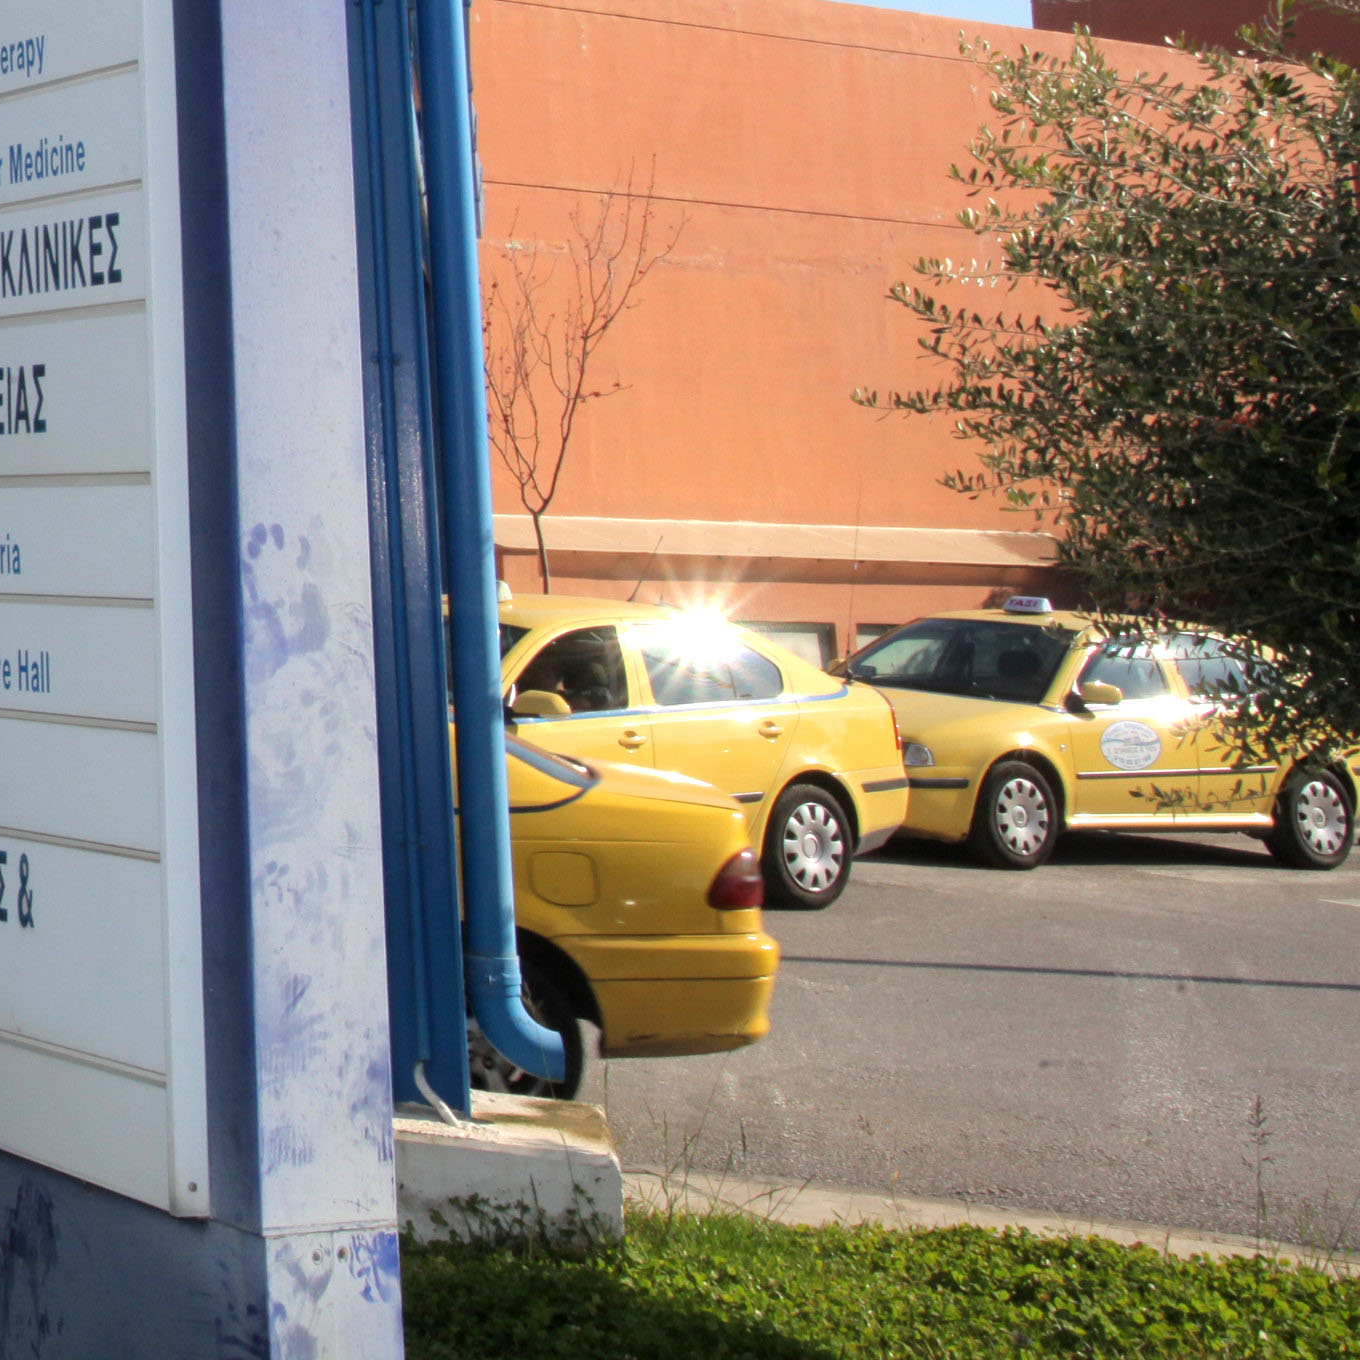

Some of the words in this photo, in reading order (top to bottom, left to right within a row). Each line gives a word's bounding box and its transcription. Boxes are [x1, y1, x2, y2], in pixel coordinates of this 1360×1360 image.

[8, 134, 86, 185] Medicine
[0, 212, 123, 299] ΚΛΙΝΙΚΕΣ
[18, 650, 51, 694] Hall
[17, 852, 35, 929] &
